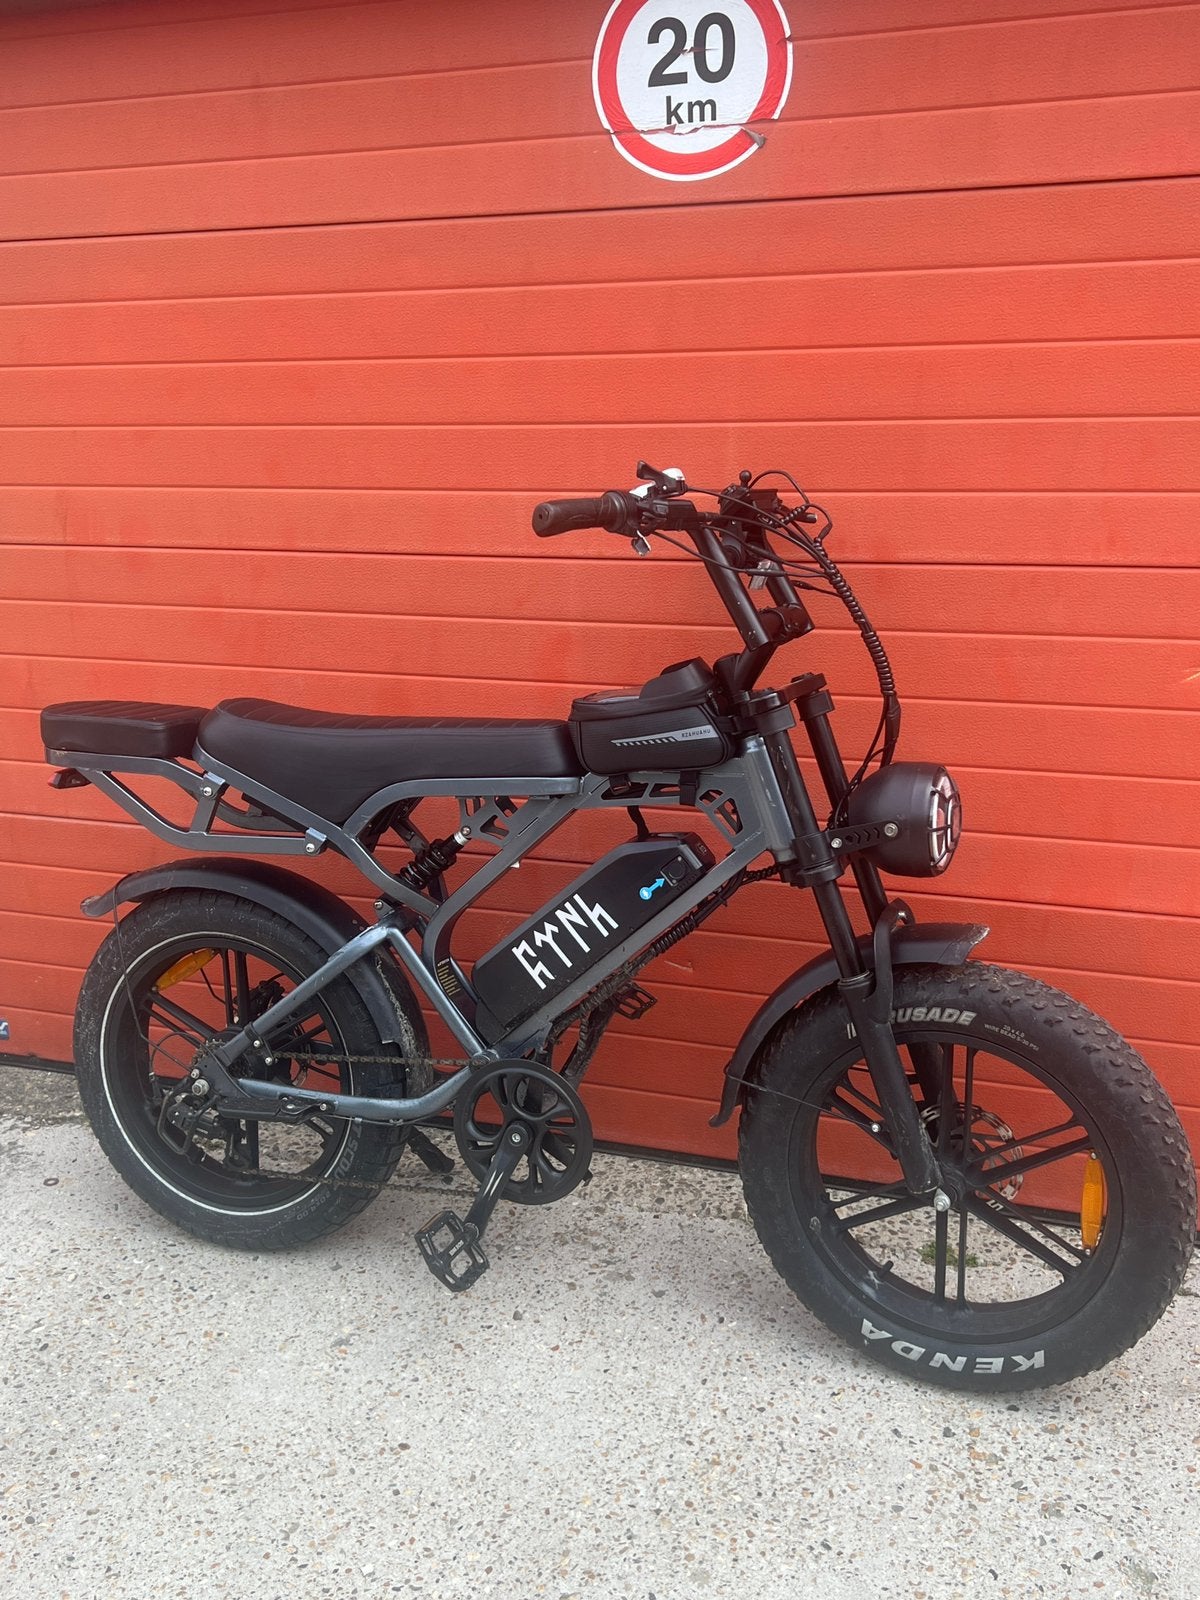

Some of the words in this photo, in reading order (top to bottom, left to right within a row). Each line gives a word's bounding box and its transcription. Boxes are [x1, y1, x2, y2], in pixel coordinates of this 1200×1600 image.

[647, 11, 736, 88] 20
[665, 95, 717, 125] km
[888, 1006, 977, 1026] USADE
[860, 1317, 1045, 1374] KENDA
